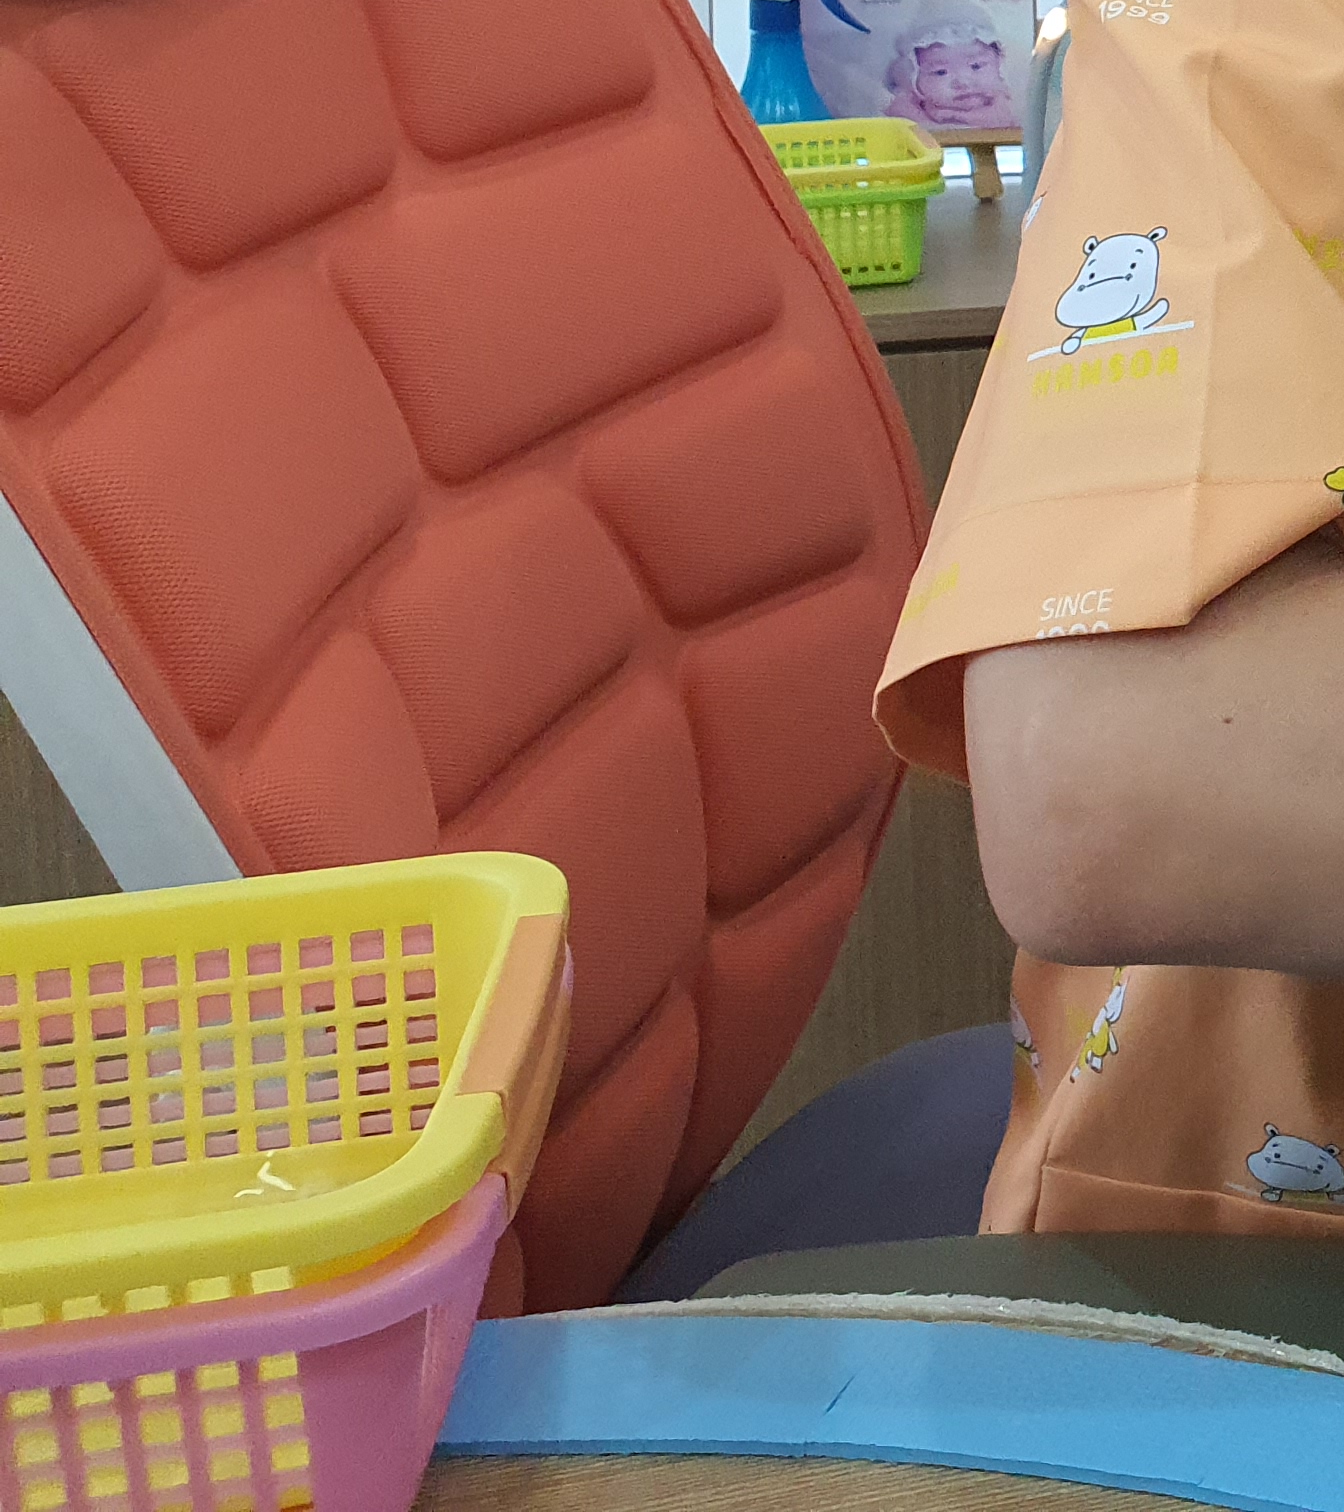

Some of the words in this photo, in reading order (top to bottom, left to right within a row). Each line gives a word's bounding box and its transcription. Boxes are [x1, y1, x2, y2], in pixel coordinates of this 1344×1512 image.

[1098, 0, 1170, 25] 1999
[1031, 345, 1180, 398] HAMSOA
[1040, 588, 1115, 622] SINCE
